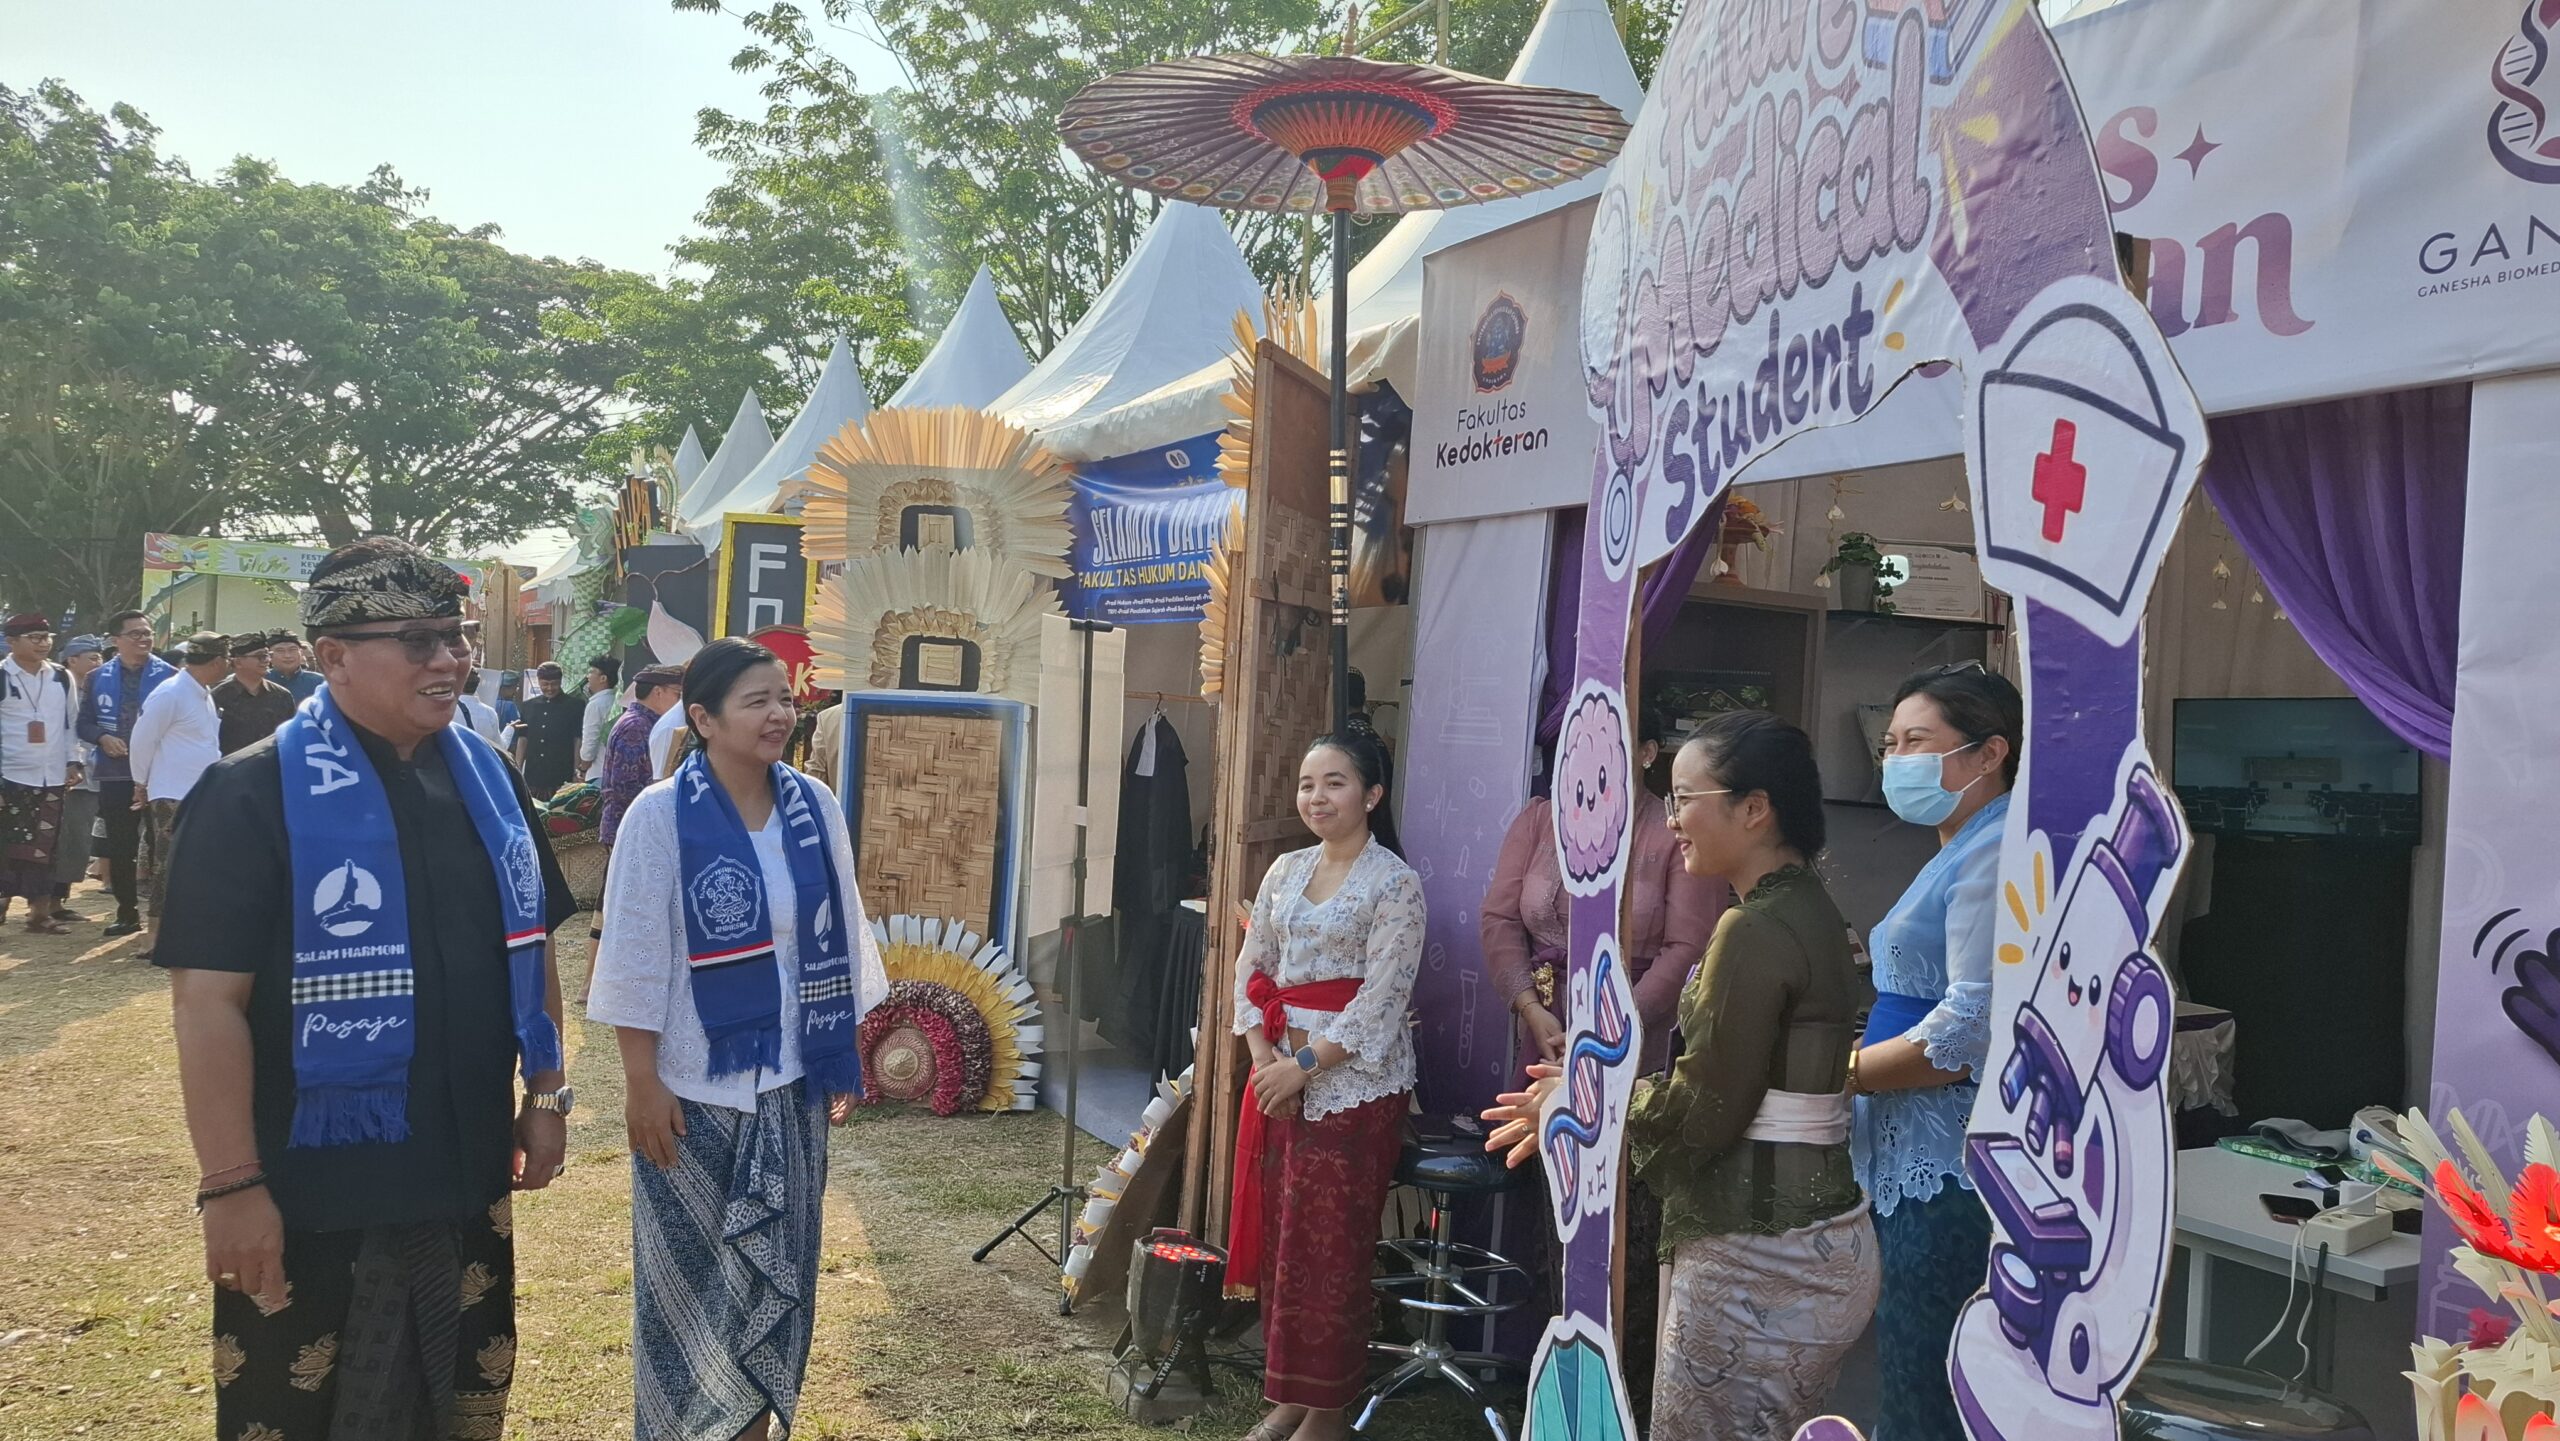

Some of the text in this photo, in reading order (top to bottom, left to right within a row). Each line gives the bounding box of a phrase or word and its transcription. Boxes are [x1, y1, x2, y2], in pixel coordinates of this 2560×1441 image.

[1629, 7, 1931, 450] Medical
[2417, 260, 2560, 298] GANESHA BIOMED
[1457, 397, 1527, 433] Fakultas
[1663, 280, 1875, 544] Student
[1436, 427, 1549, 469] Kedokteran
[1090, 501, 1171, 567] SELAMAT
[1078, 558, 1208, 590] FAKULTAS HUKUM DAN
[295, 943, 406, 963] SALAM HARMONI
[302, 1012, 407, 1048] Pesaje
[806, 1008, 854, 1036] Pesaje
[1156, 1339, 1185, 1385] ATM LIGHT
